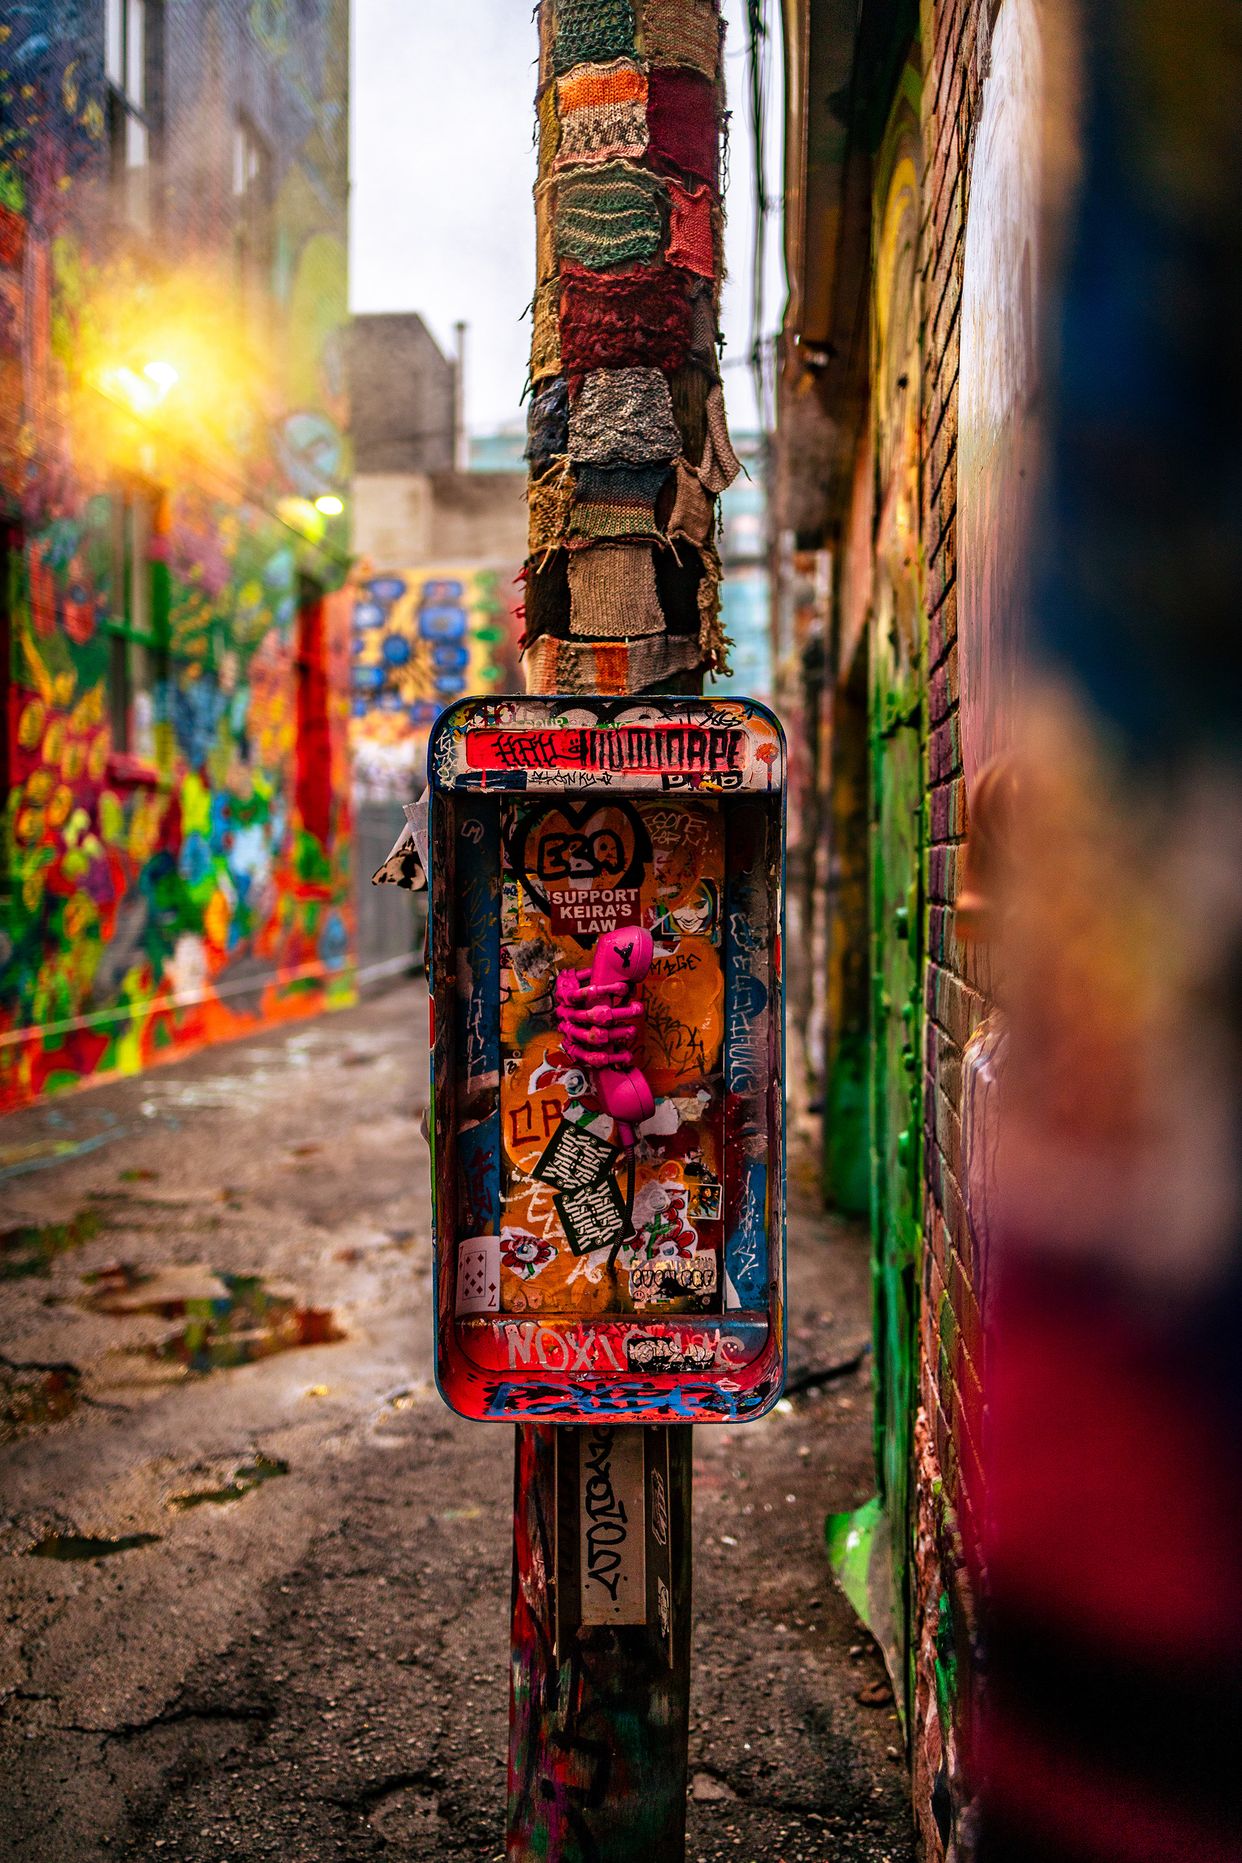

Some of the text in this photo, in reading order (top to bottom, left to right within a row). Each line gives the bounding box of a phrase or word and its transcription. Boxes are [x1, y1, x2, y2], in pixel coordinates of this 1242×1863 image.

[552, 889, 638, 904] SUPPORT
[560, 904, 632, 919] KEIRA'S
[577, 919, 617, 933] LAW
